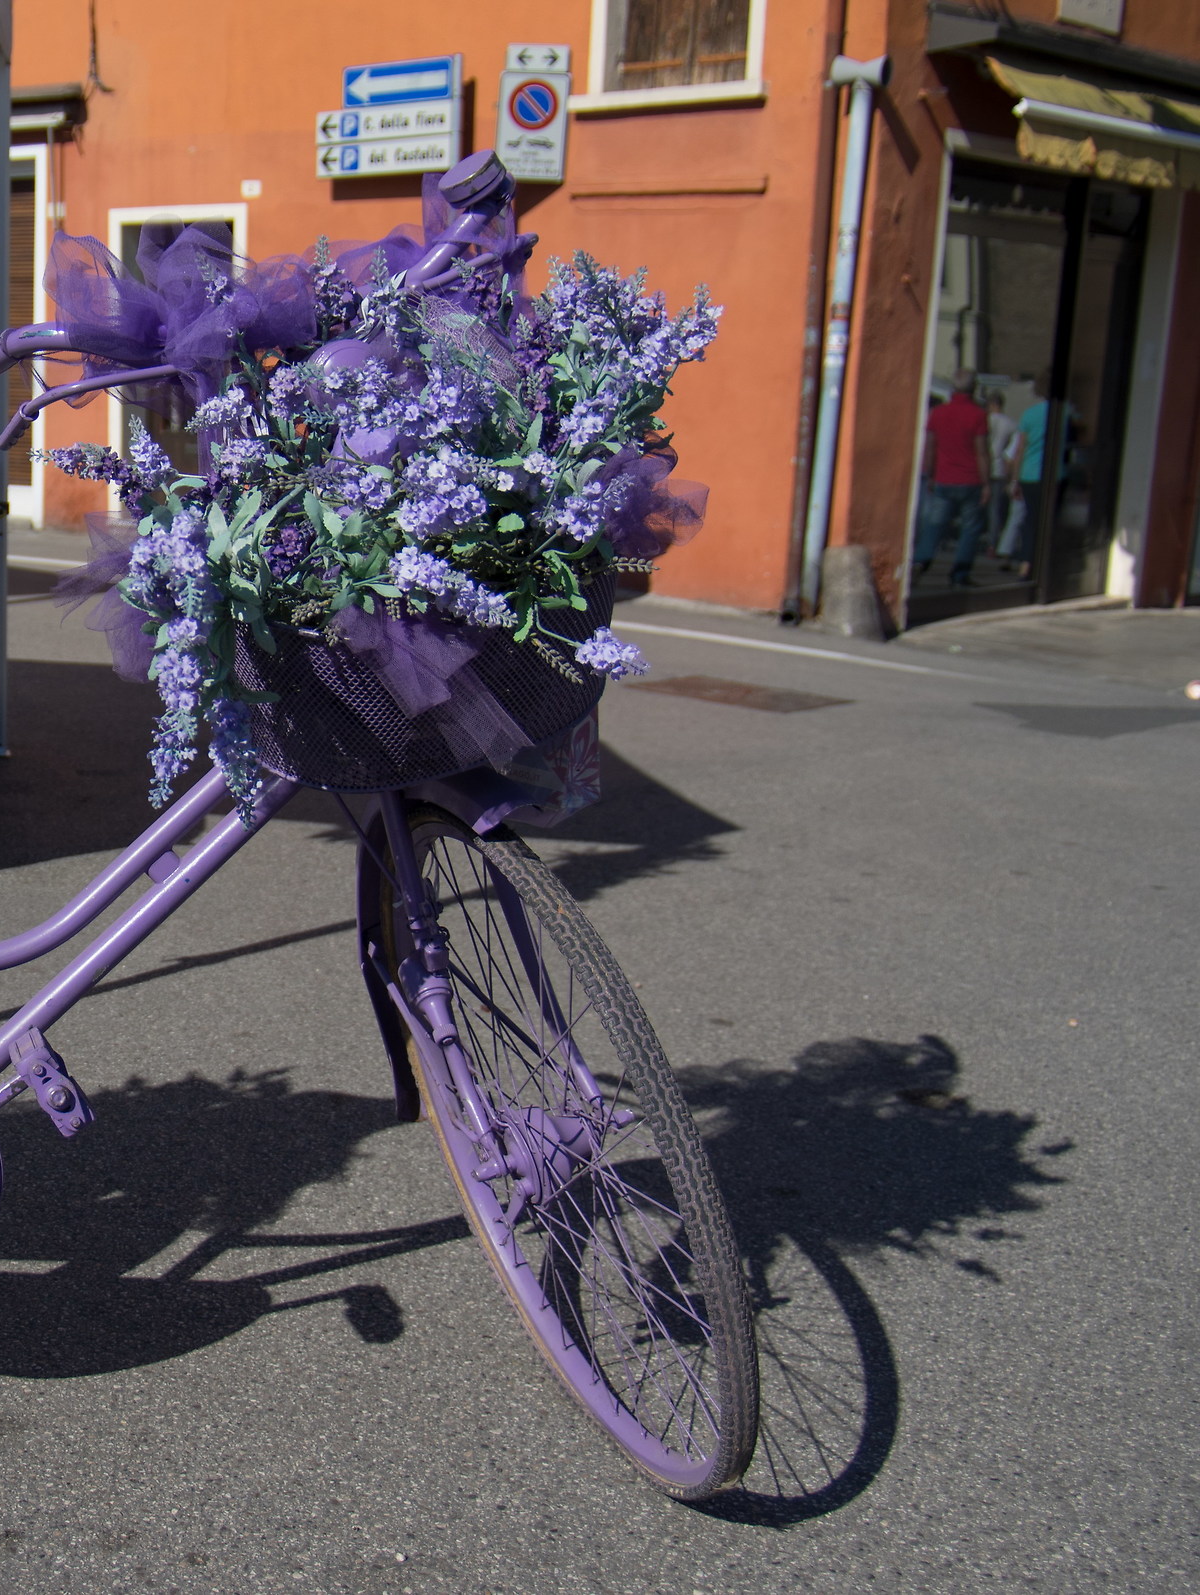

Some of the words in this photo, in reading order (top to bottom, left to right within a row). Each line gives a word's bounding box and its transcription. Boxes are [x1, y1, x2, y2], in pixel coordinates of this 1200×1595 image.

[380, 113, 410, 129] della
[370, 148, 387, 163] del
[394, 145, 445, 161] Castello
